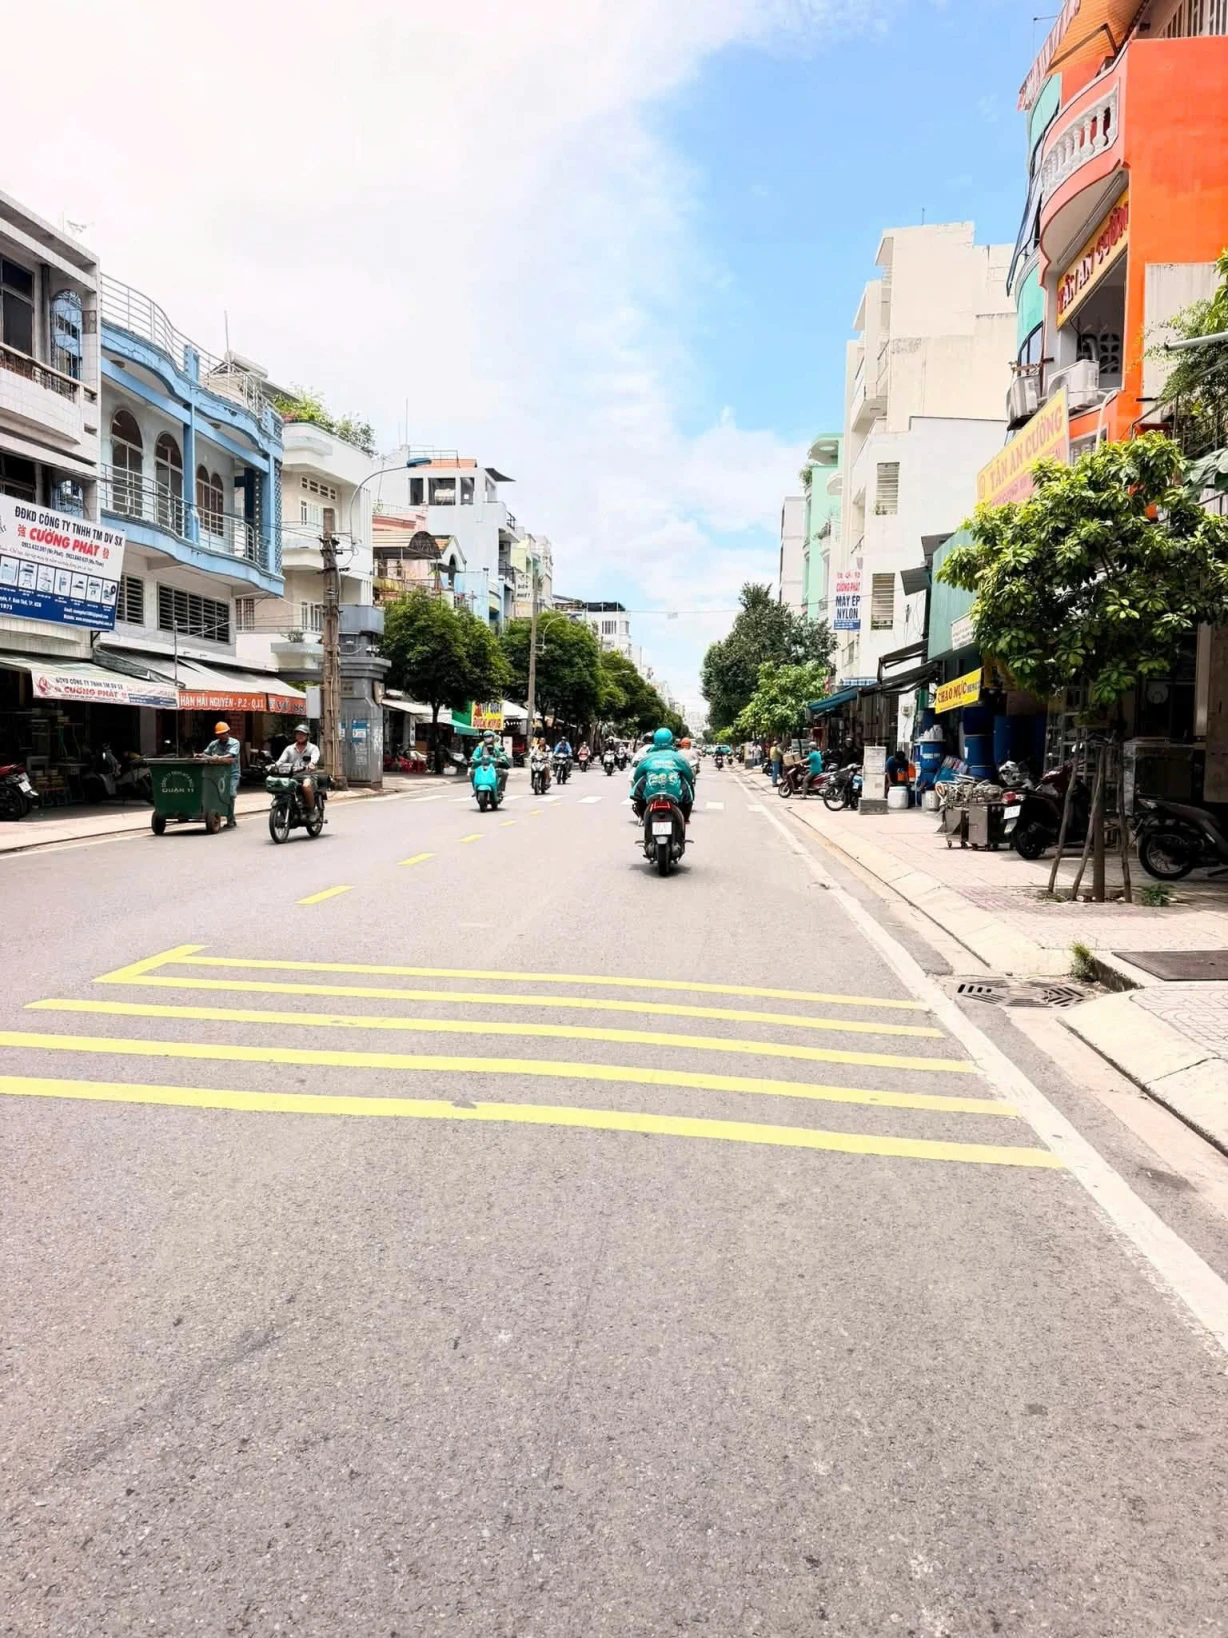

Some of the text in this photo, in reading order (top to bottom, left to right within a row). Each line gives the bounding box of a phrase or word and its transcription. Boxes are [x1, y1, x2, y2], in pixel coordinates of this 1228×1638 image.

[990, 457, 1008, 492] TÂN
[1010, 442, 1024, 475] AN
[1025, 403, 1064, 459] CƯỜNG
[38, 511, 60, 529] CÔNG
[62, 520, 71, 531] TY
[72, 522, 91, 538] TNHH
[92, 528, 103, 541] TM
[104, 532, 114, 545] DV
[114, 535, 124, 547] SX
[29, 527, 71, 549] CƯỜNG
[71, 539, 100, 557] PHÁT
[835, 592, 861, 607] MÁY ÉP
[836, 607, 859, 619] NYLON
[64, 685, 96, 696] CƯỜNG
[97, 688, 119, 698] PHÁT
[196, 693, 209, 707] HẢI
[209, 695, 234, 708] NGUYÊN
[237, 697, 248, 708] P.2
[251, 698, 264, 710] Q.11
